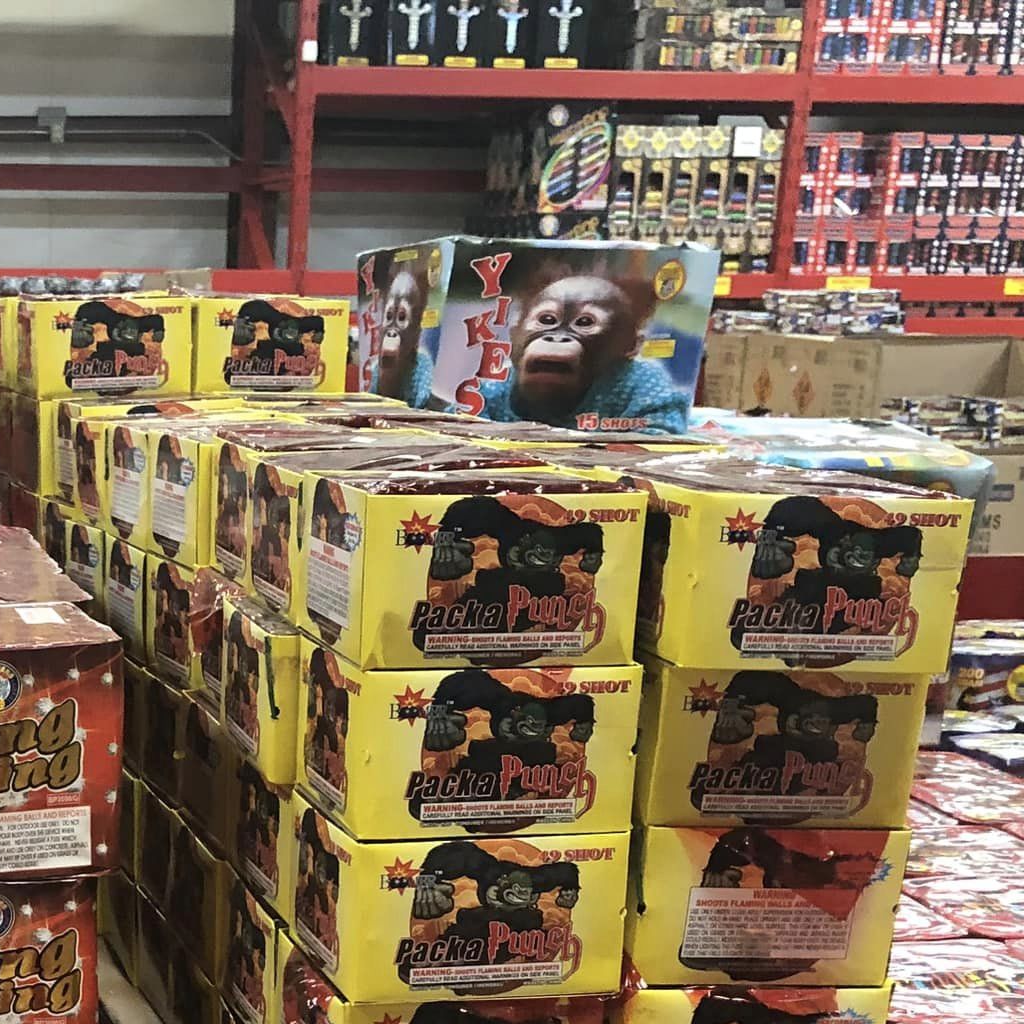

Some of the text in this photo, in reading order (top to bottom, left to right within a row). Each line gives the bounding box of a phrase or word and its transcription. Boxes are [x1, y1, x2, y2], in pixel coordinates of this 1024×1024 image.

[576, 413, 648, 430] 15 SHOTS
[589, 508, 641, 523] SHOT
[908, 513, 962, 528] SHOT
[579, 679, 632, 694] SHOT
[564, 848, 616, 862] SHOT
